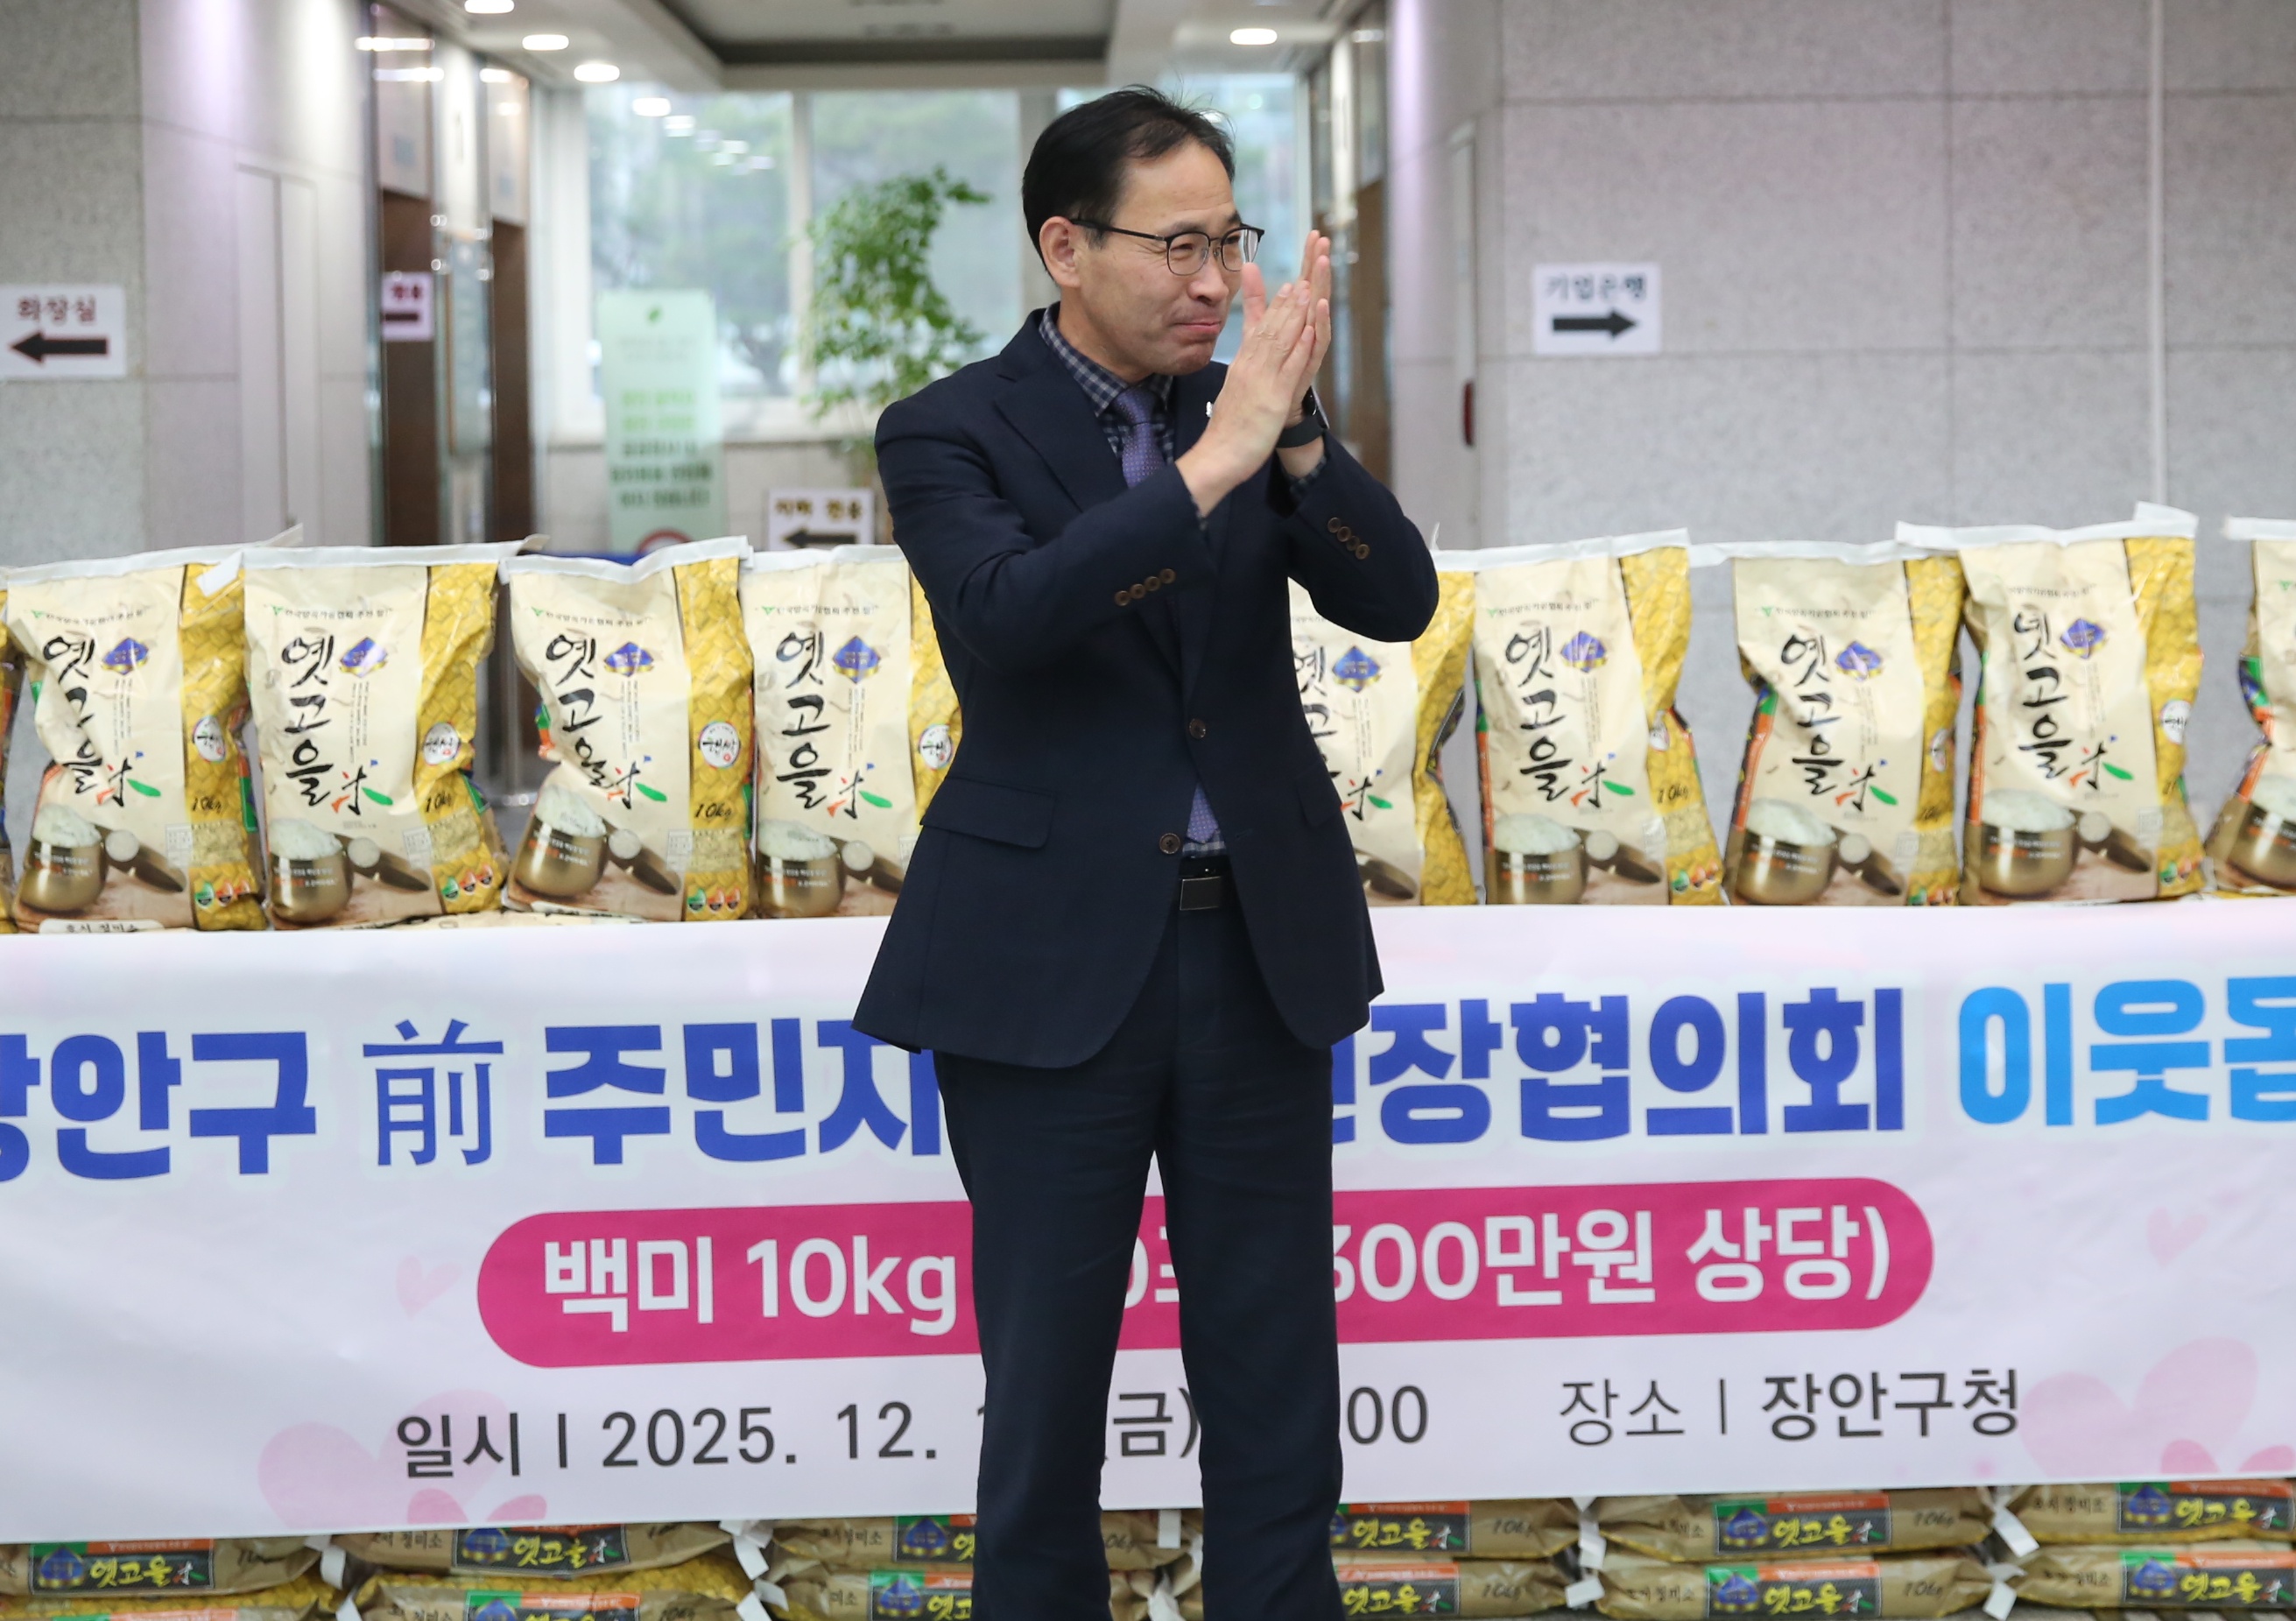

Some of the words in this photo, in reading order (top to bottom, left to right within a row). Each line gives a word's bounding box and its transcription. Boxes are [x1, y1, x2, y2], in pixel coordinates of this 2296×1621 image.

[18, 295, 96, 325] 화장실
[0, 1031, 317, 1183] 안구
[363, 1018, 504, 1166] 前
[544, 1235, 714, 1333] 백미
[746, 1234, 958, 1336] 10kg
[1686, 1204, 1891, 1302] 상당)
[397, 1412, 521, 1478] 일시
[602, 1406, 798, 1468] 2025.
[836, 1401, 938, 1460] 12.
[1560, 1378, 1686, 1448] 장소
[1761, 1368, 2018, 1441] 장안구청
